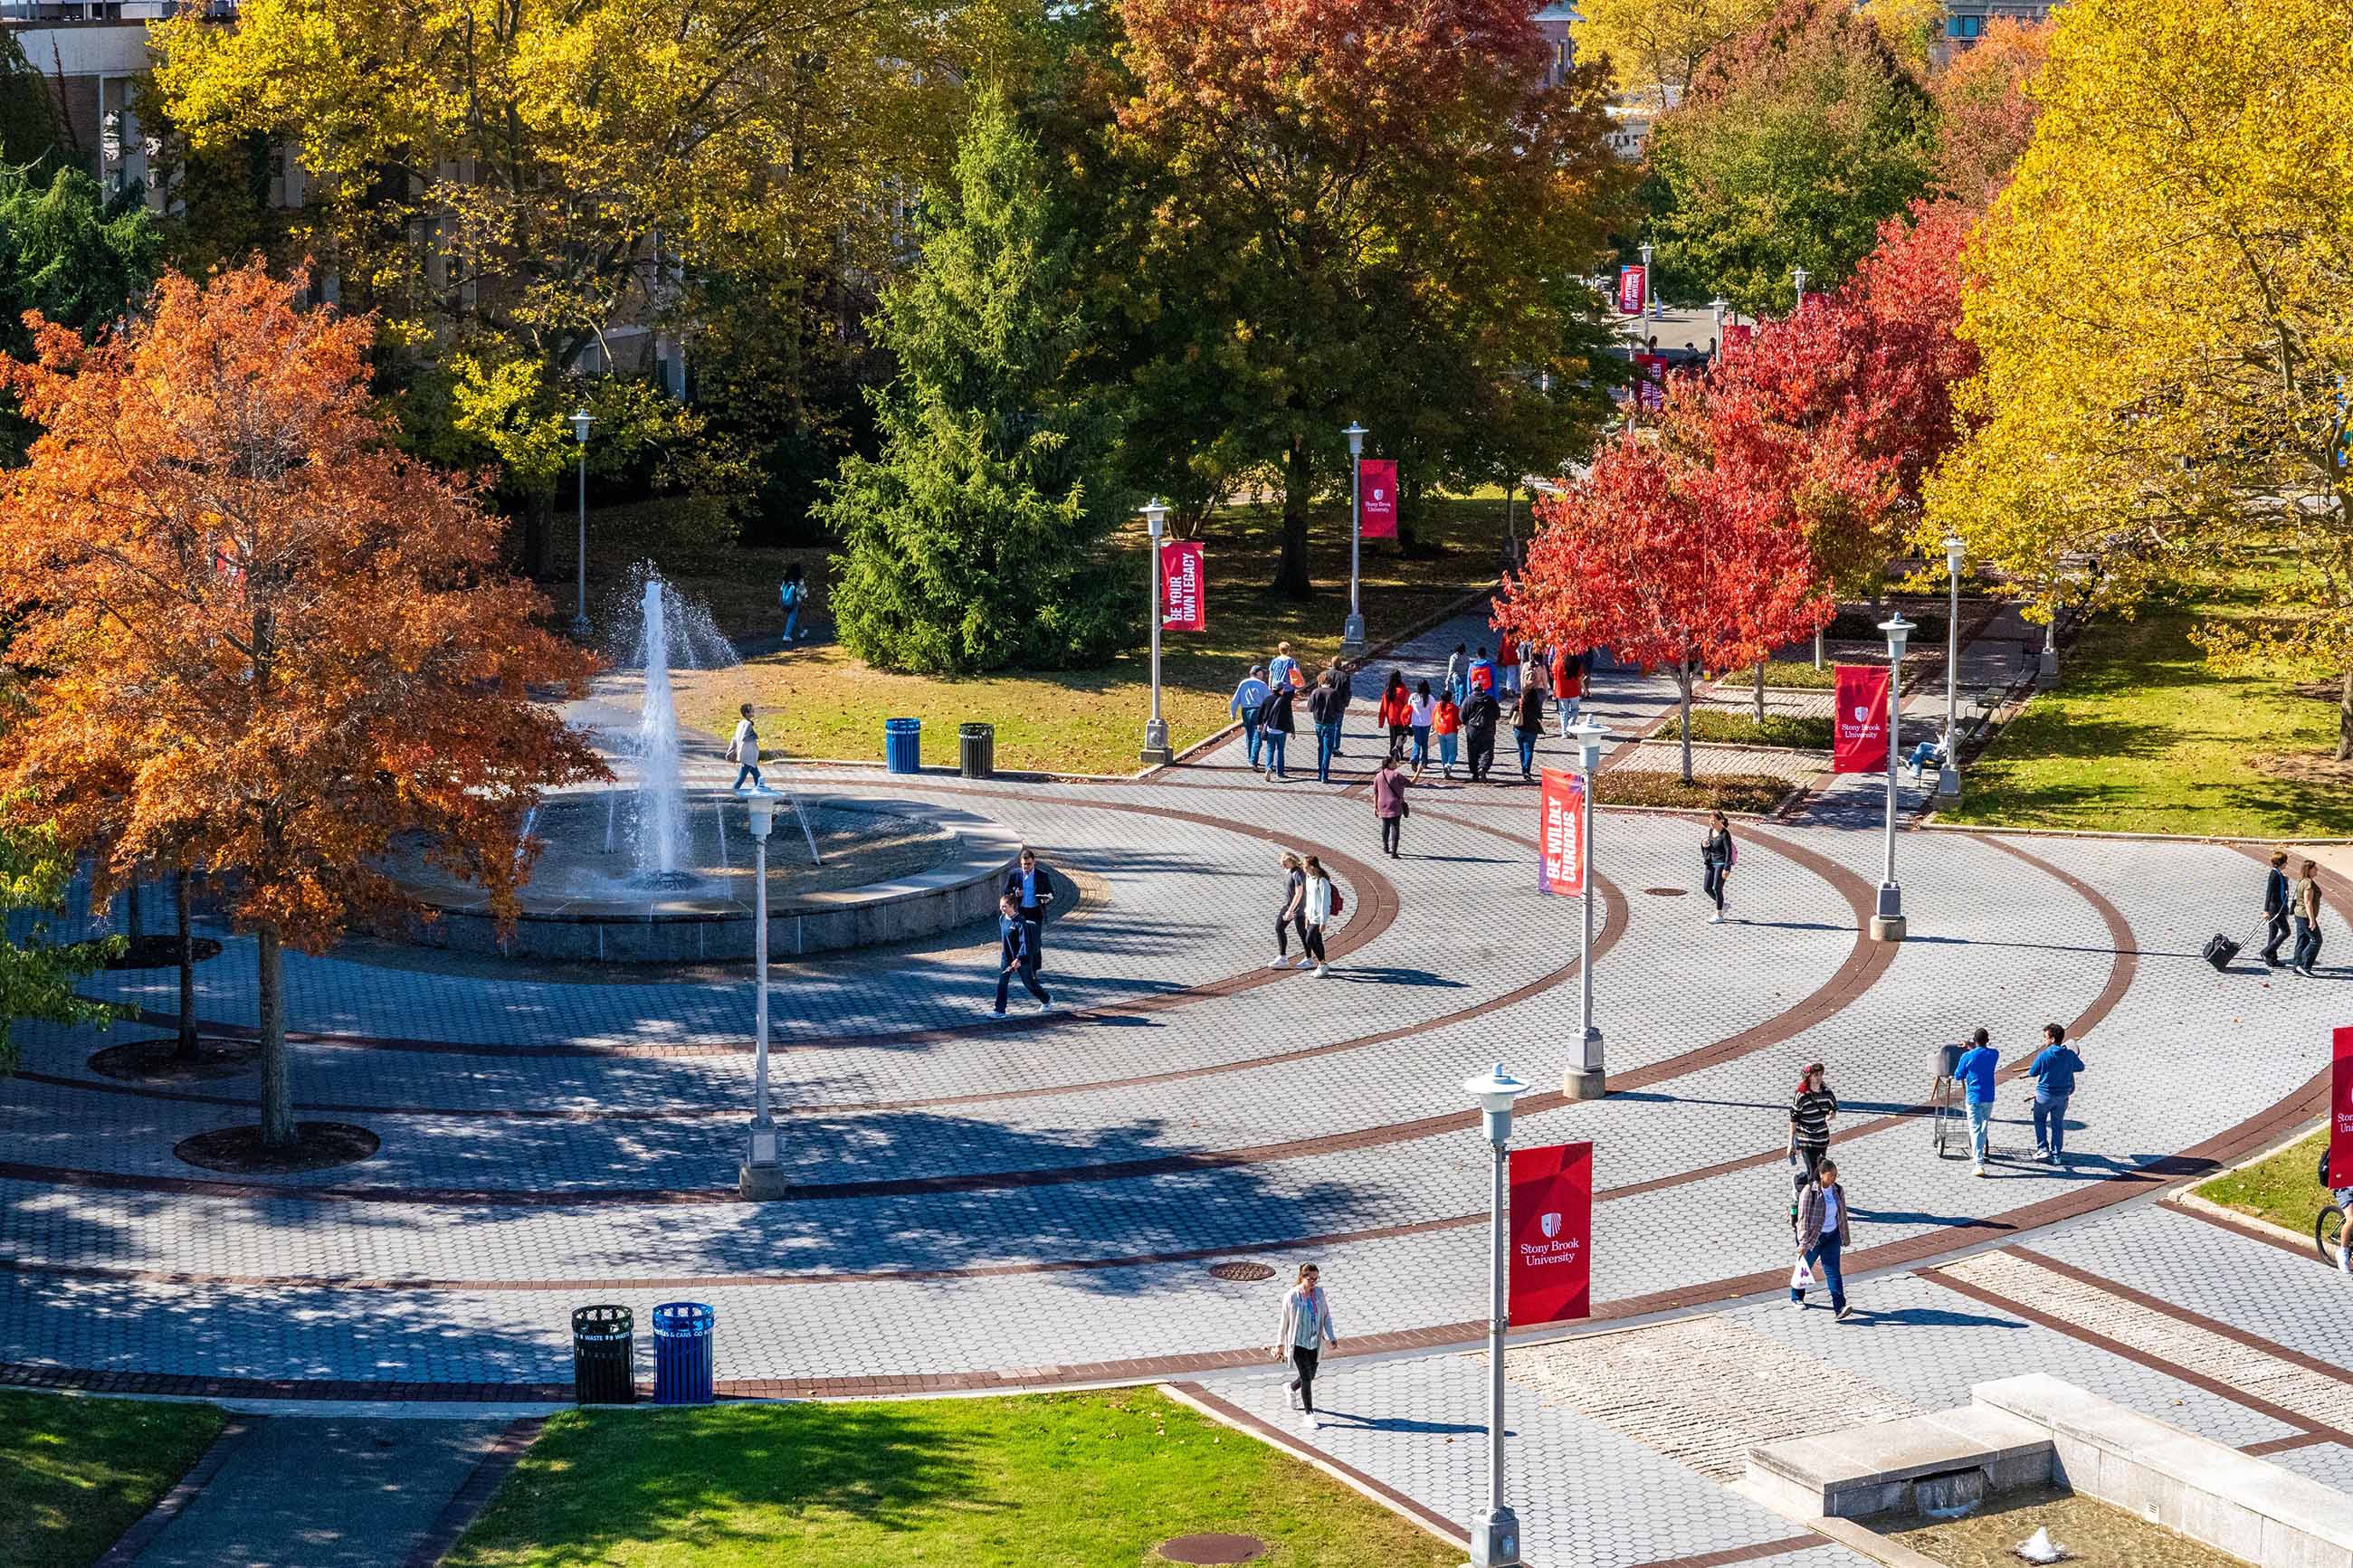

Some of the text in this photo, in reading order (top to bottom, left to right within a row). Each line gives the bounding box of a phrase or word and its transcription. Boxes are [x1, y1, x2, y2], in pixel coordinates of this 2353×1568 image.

[1169, 575, 1183, 621] BE YOUR
[1183, 553, 1196, 622] OWN LEGACY
[1841, 723, 1881, 732] Stony Brook
[1844, 730, 1878, 739] University
[1546, 795, 1564, 879] BE WILDLY
[1561, 810, 1577, 883] CURIOUS
[1520, 1238, 1579, 1255] Stony Brook
[1525, 1251, 1576, 1267] University
